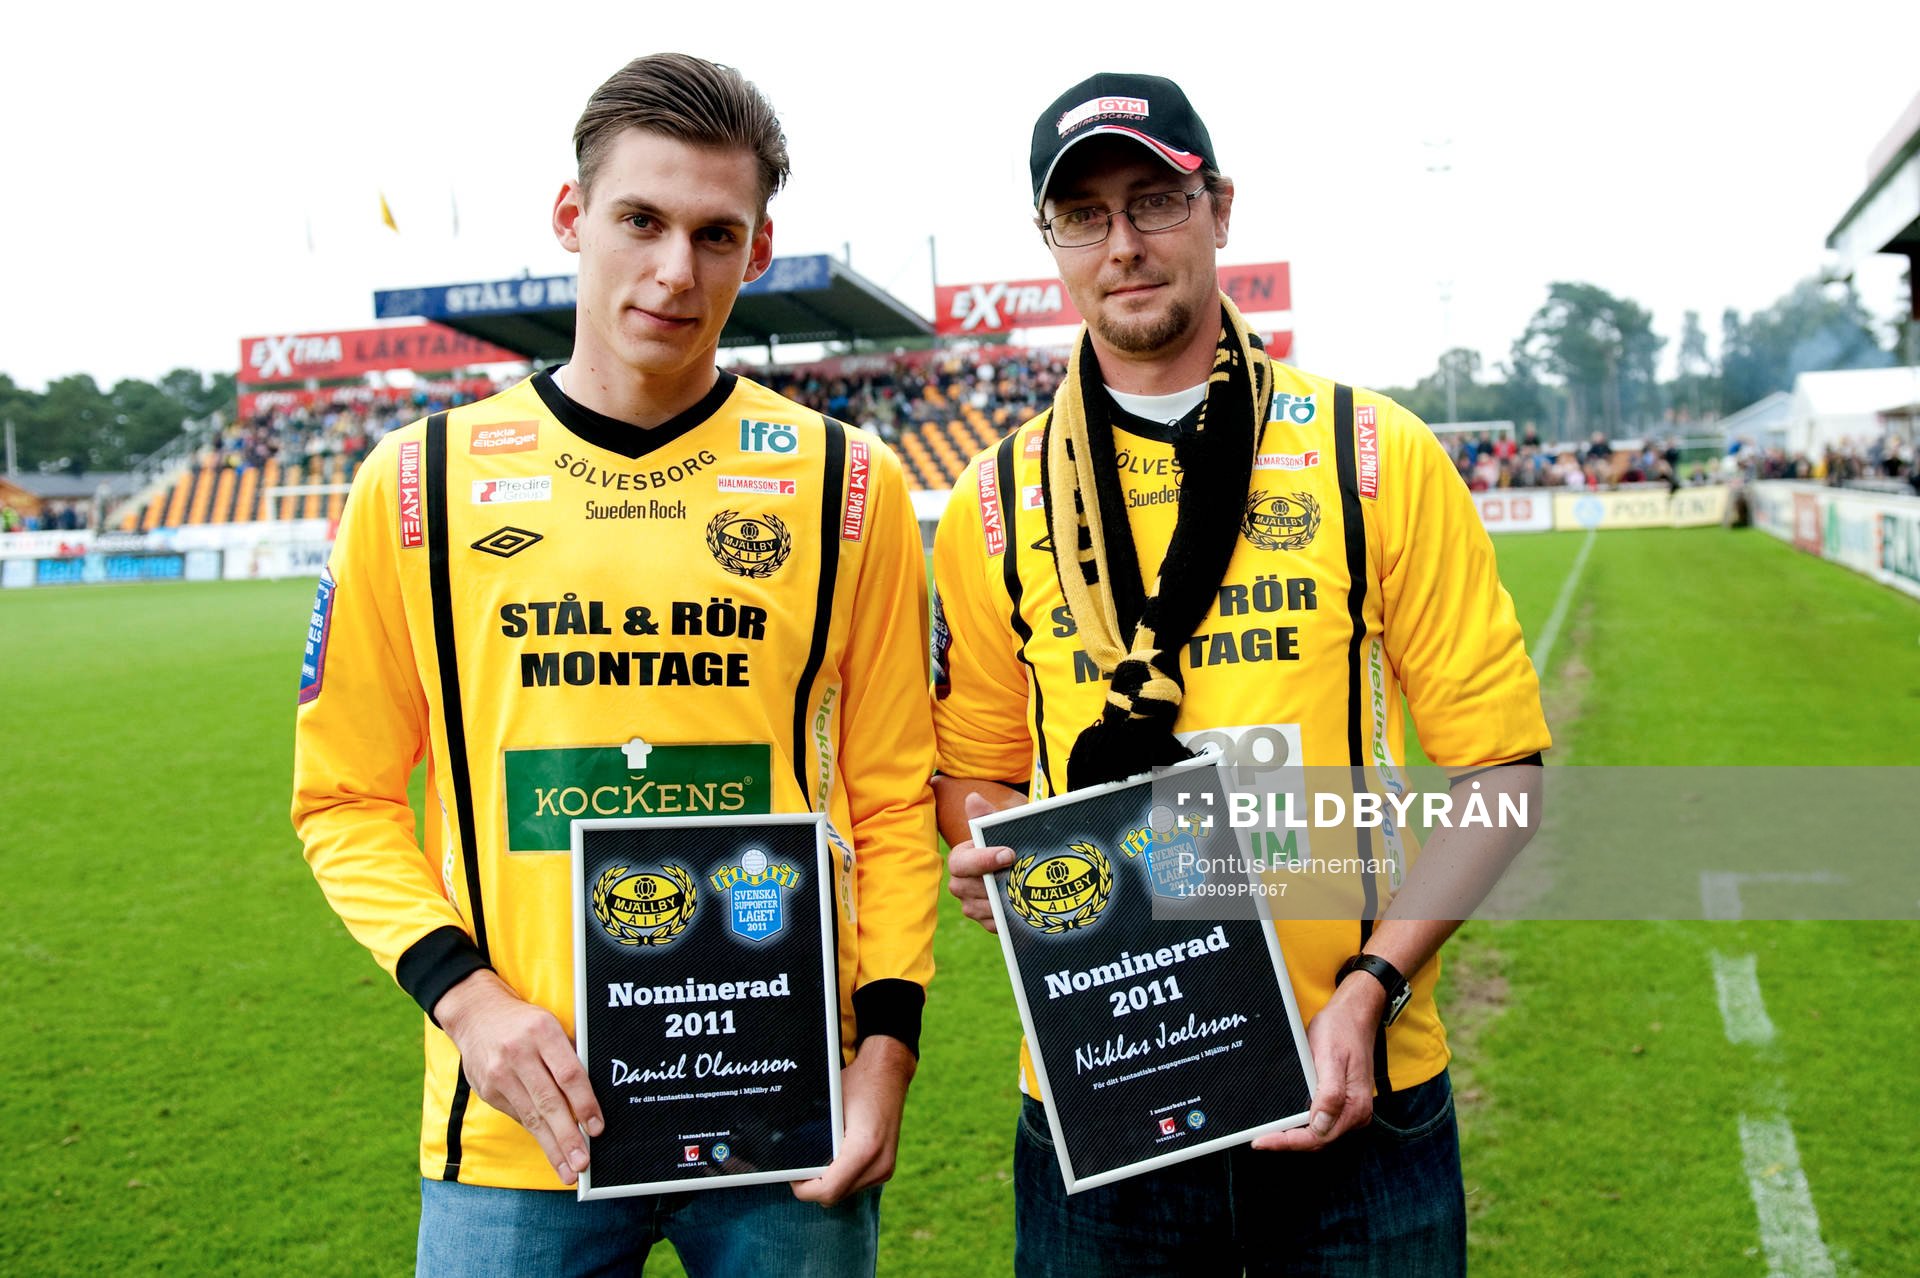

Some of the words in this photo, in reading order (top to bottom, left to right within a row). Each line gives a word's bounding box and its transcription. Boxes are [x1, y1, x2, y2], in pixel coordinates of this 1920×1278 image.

[1101, 100, 1141, 111] GYM
[951, 284, 1063, 331] EXTRA
[250, 335, 343, 378] EXTRA
[355, 331, 485, 362] LÄKTARE
[1271, 393, 1316, 424] fö
[472, 433, 537, 448] Elbolaget
[478, 428, 516, 440] Enkla
[741, 419, 797, 453] Ifö
[1357, 407, 1376, 452] TEAM
[554, 450, 718, 491] SÖLVESBORG
[850, 441, 868, 490] TEAM
[1116, 449, 1184, 475] ÖLVES
[1254, 456, 1304, 467] ALMARSSONS
[1361, 453, 1378, 493] SPORTIA
[498, 478, 550, 492] Predire
[503, 489, 545, 502] Group
[718, 478, 778, 490] HJALMARSSONS
[402, 487, 422, 546] TEAM
[585, 499, 645, 520] Sweden
[650, 499, 686, 520] Rock
[844, 491, 864, 539] SPORTIA
[723, 535, 775, 552] MJÄLLBY
[982, 501, 1003, 554] TEAM
[1218, 574, 1318, 617] RÖR
[500, 592, 612, 638] STÅL
[623, 606, 659, 636] &
[672, 597, 768, 641] RÖR
[521, 651, 750, 688] MONTAGE
[535, 779, 746, 817] KOCKENS
[734, 889, 778, 900] SVENSKA
[1030, 873, 1093, 901] MJÄLLBY
[614, 897, 677, 915] MJÄLLBY
[734, 900, 778, 910] SUPPORTER
[738, 910, 775, 923] LAGET
[747, 923, 767, 932] 2011
[1044, 926, 1230, 999] Nominerad
[608, 973, 790, 1007] Nominerad
[1109, 975, 1183, 1018] 2011
[665, 1010, 736, 1038] 2011
[1074, 1033, 1151, 1075] Niklas
[1155, 1013, 1247, 1049] Joelsson
[611, 1053, 687, 1087] Daniel
[695, 1051, 798, 1079] Olausson
[1093, 1082, 1105, 1090] För
[1106, 1077, 1119, 1086] ditt
[1119, 1067, 1157, 1082] fantastiska
[1157, 1054, 1200, 1071] engagemang
[1231, 1040, 1243, 1049] AIF
[657, 1093, 694, 1102] fantastiska
[695, 1089, 739, 1099] engagemang
